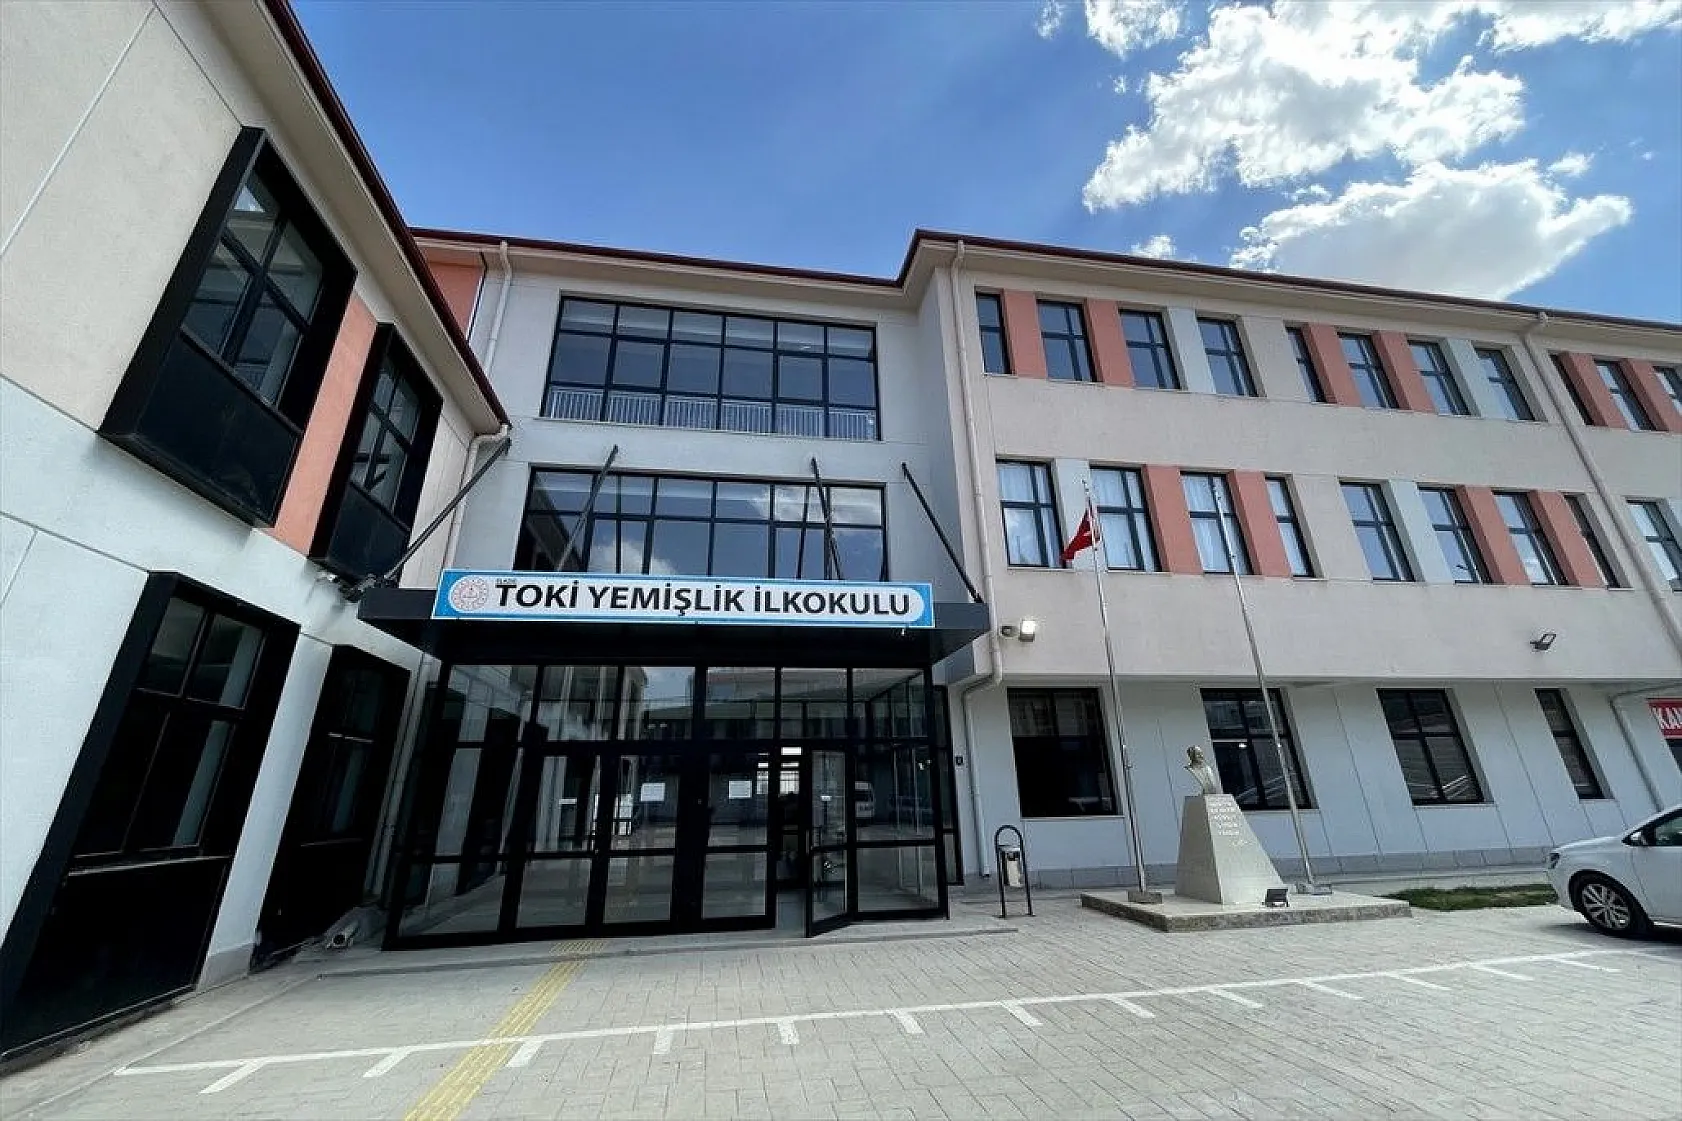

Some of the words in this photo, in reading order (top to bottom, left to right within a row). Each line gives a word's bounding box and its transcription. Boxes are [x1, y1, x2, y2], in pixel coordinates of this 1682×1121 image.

[495, 580, 579, 607] TOKİ
[589, 582, 744, 616] YEMİŞLİK
[754, 585, 910, 615] İLKOKULU
